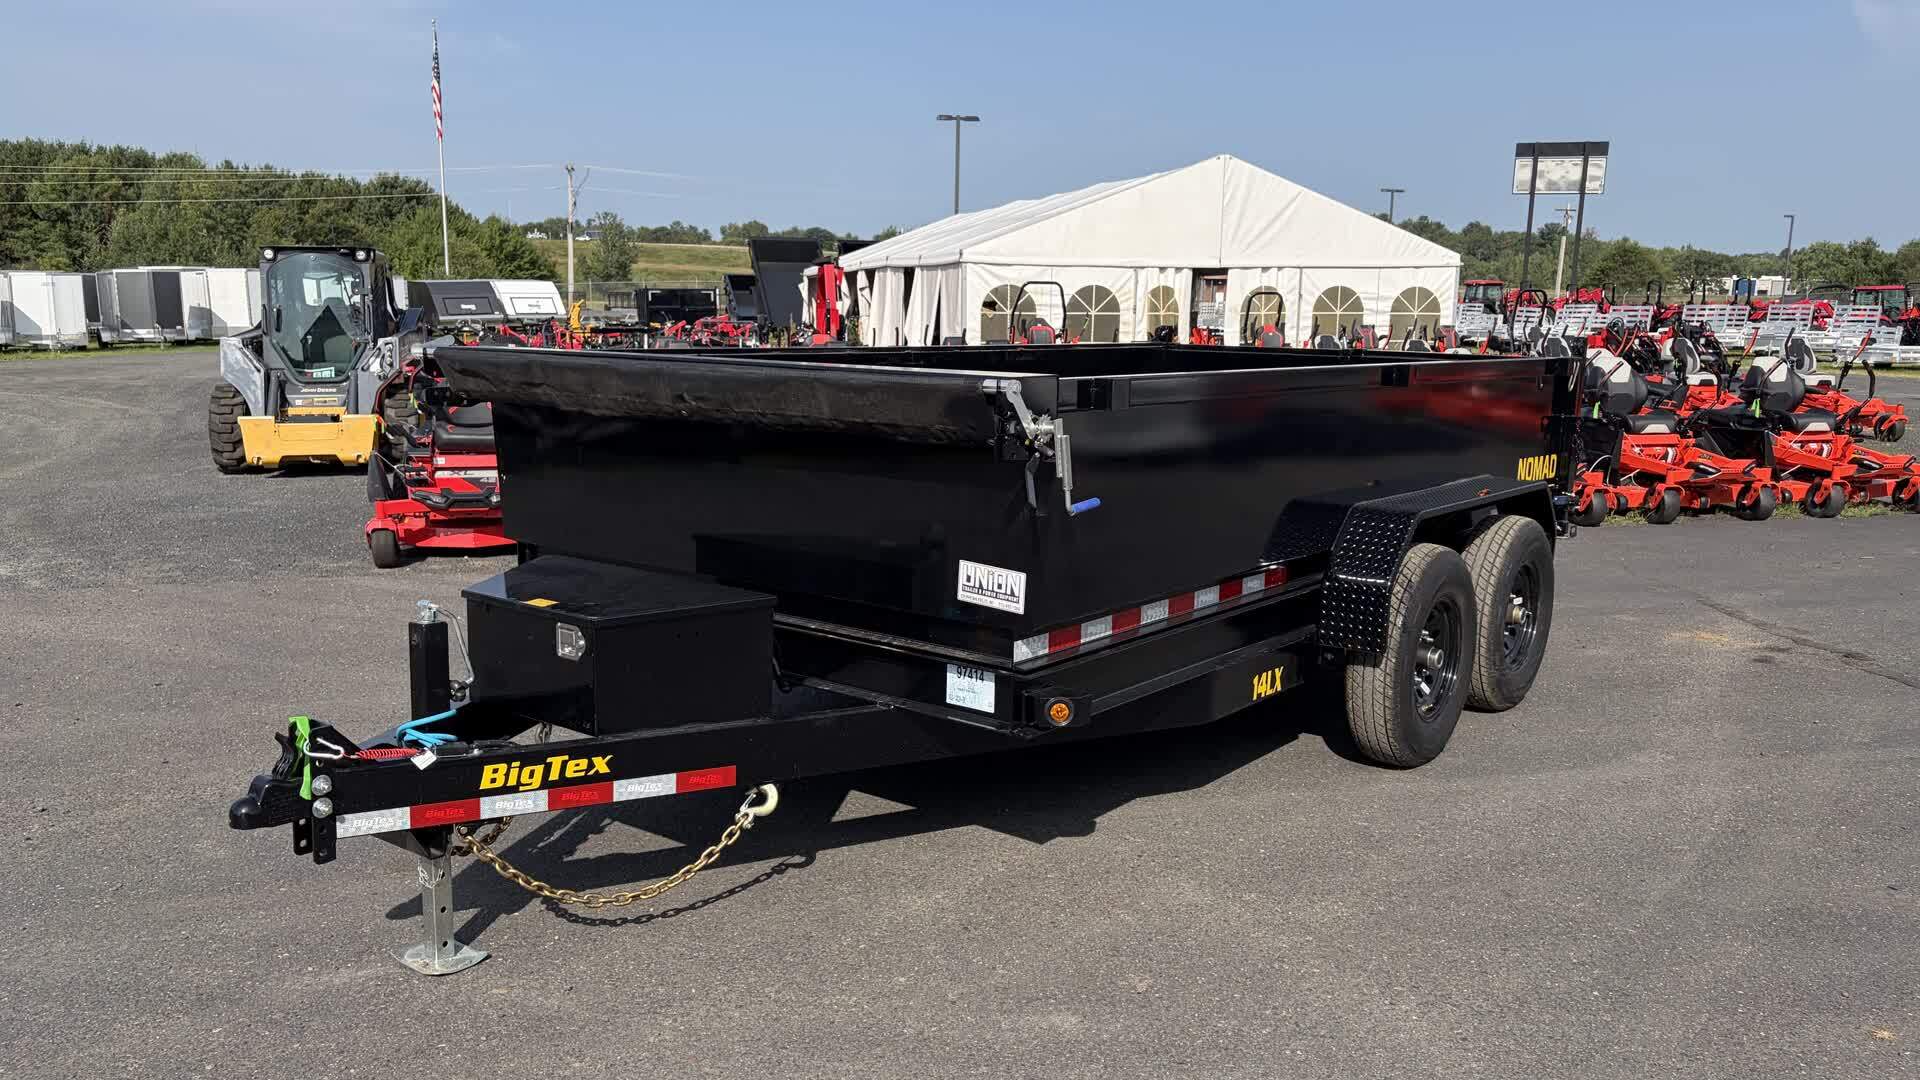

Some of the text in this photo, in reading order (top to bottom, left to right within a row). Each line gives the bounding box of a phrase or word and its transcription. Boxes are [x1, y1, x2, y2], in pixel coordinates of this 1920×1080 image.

[1517, 453, 1557, 481] NOMAD
[956, 665, 985, 683] 97414
[1252, 665, 1284, 701] 14LX
[479, 754, 614, 792] BigTex
[353, 815, 395, 829] BigTex
